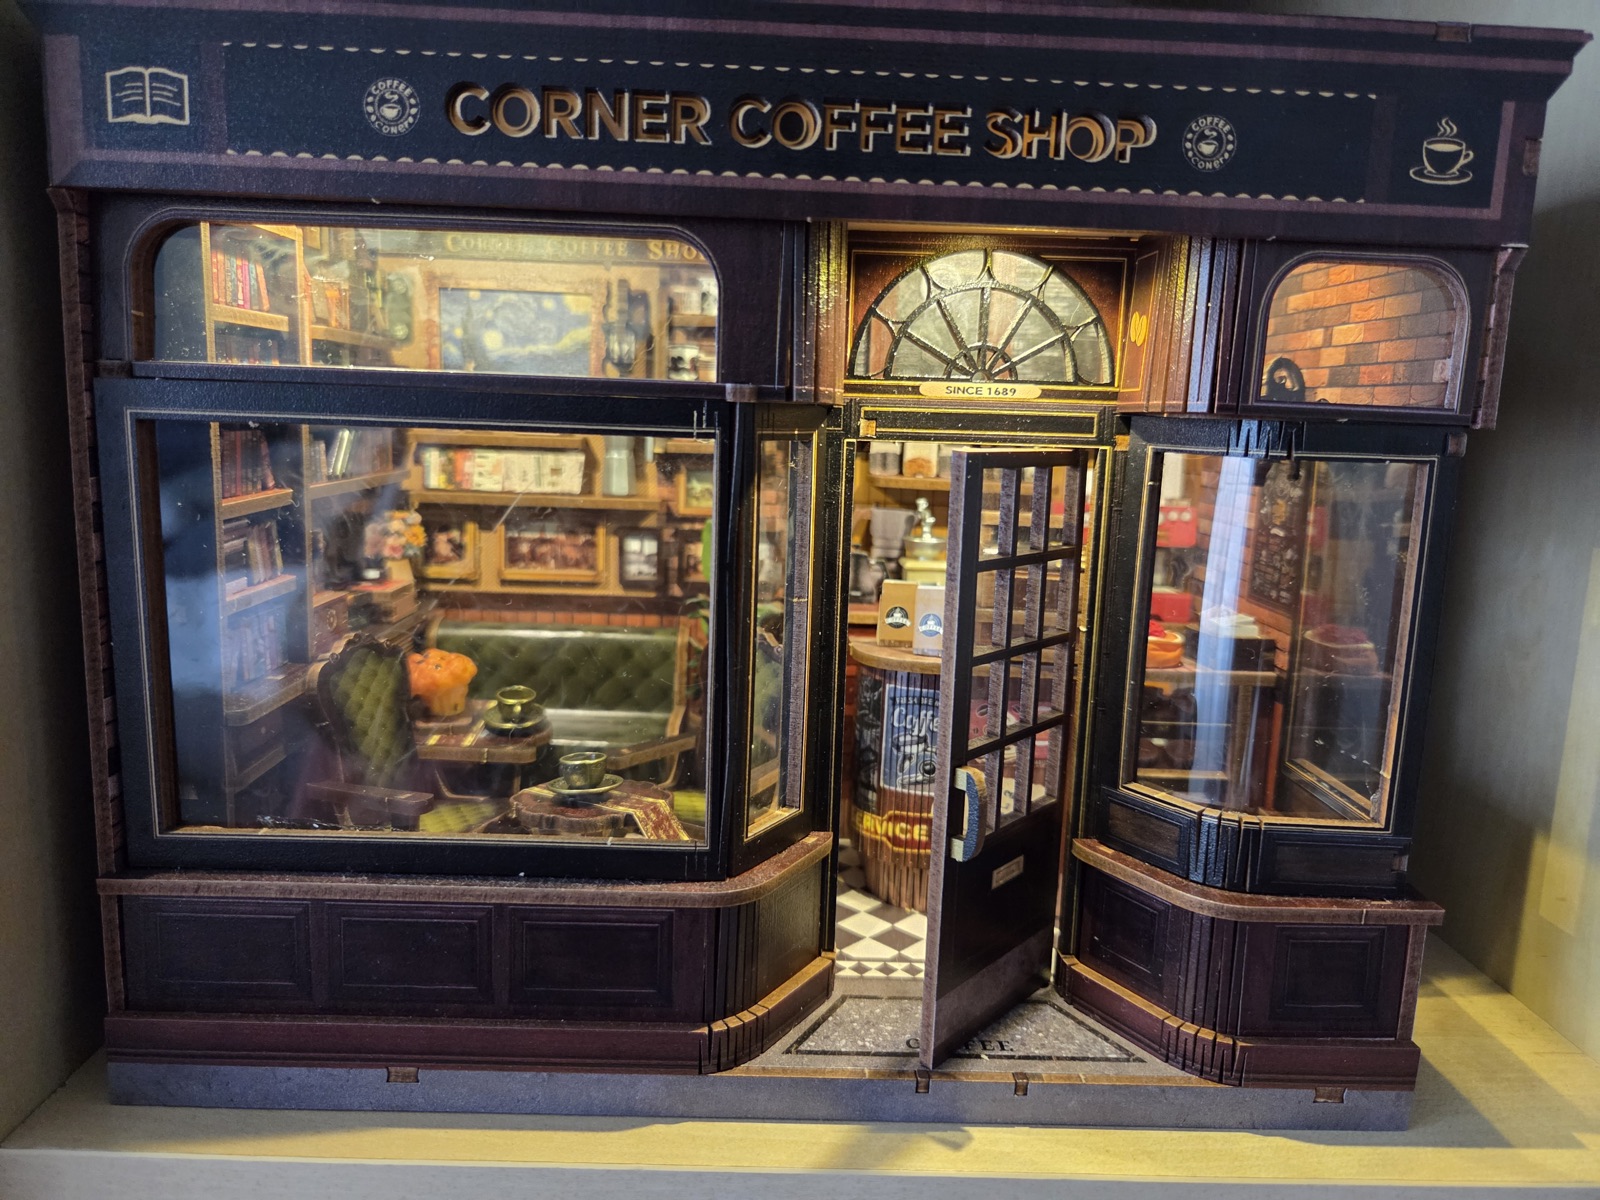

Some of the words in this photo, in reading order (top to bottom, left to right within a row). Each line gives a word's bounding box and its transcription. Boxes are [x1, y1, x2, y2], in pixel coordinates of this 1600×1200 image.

[371, 79, 413, 97] COFFEE
[445, 80, 713, 145] CORNER
[728, 93, 973, 158] COFFEE
[982, 105, 1158, 164] SHOP
[1191, 116, 1231, 134] COFFEE
[945, 386, 983, 395] SINCE
[987, 387, 1017, 396] 1689
